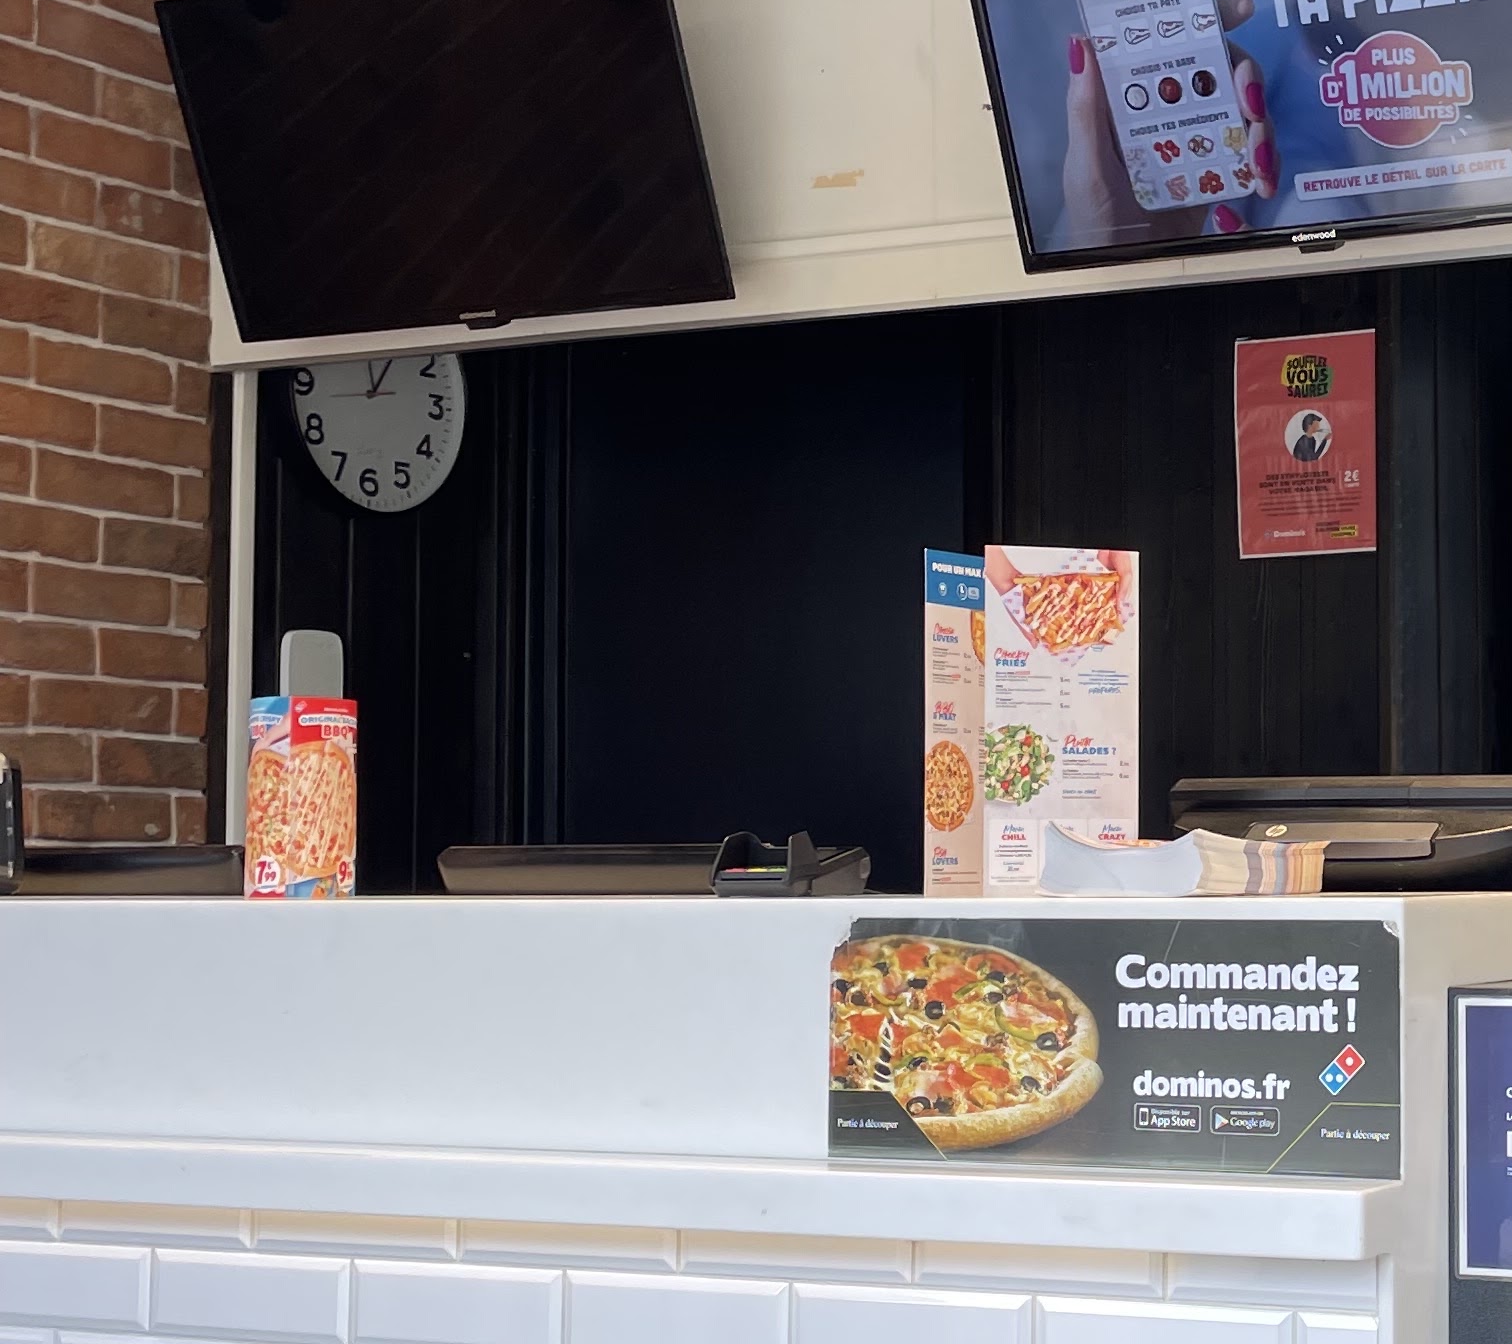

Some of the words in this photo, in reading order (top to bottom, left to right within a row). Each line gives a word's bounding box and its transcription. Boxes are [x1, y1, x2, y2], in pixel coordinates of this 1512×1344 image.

[1371, 47, 1416, 66] PLUS
[1360, 69, 1466, 100] MILLION
[1344, 107, 1361, 122] DE
[1366, 102, 1454, 121] POSSIBILITÉS
[1303, 175, 1361, 193] RETROUVE
[1365, 174, 1379, 185] LE
[1382, 167, 1421, 185] DÉTAIL
[1426, 166, 1448, 179] SUR
[1452, 162, 1466, 174] LA
[1469, 158, 1507, 174] CARTE
[1291, 228, 1336, 243] edenwood
[295, 367, 314, 396] 9
[1286, 368, 1329, 385] VOUS
[428, 393, 444, 420] 3
[304, 413, 325, 445] 8
[416, 434, 433, 459] 4
[331, 450, 348, 481] 7
[393, 461, 411, 490] 5
[359, 468, 379, 497] 6
[932, 562, 953, 574] POUR
[965, 567, 981, 577] MAX
[995, 659, 1027, 668] FRIES
[322, 725, 349, 739] BBQ
[1062, 747, 1109, 755] SALADES
[1115, 954, 1360, 992] Commandez
[1118, 994, 1338, 1033] maintenant
[1347, 998, 1357, 1033] !
[1133, 1070, 1290, 1099] dominos.fr
[836, 1118, 858, 1129] Partie
[866, 1118, 899, 1131] découper
[1151, 1117, 1170, 1128] App
[1170, 1116, 1196, 1128] Store
[1229, 1117, 1258, 1129] Google
[1259, 1117, 1276, 1129] play
[1320, 1129, 1345, 1139] Partie
[1346, 1129, 1352, 1139] à
[1352, 1129, 1391, 1141] découper
